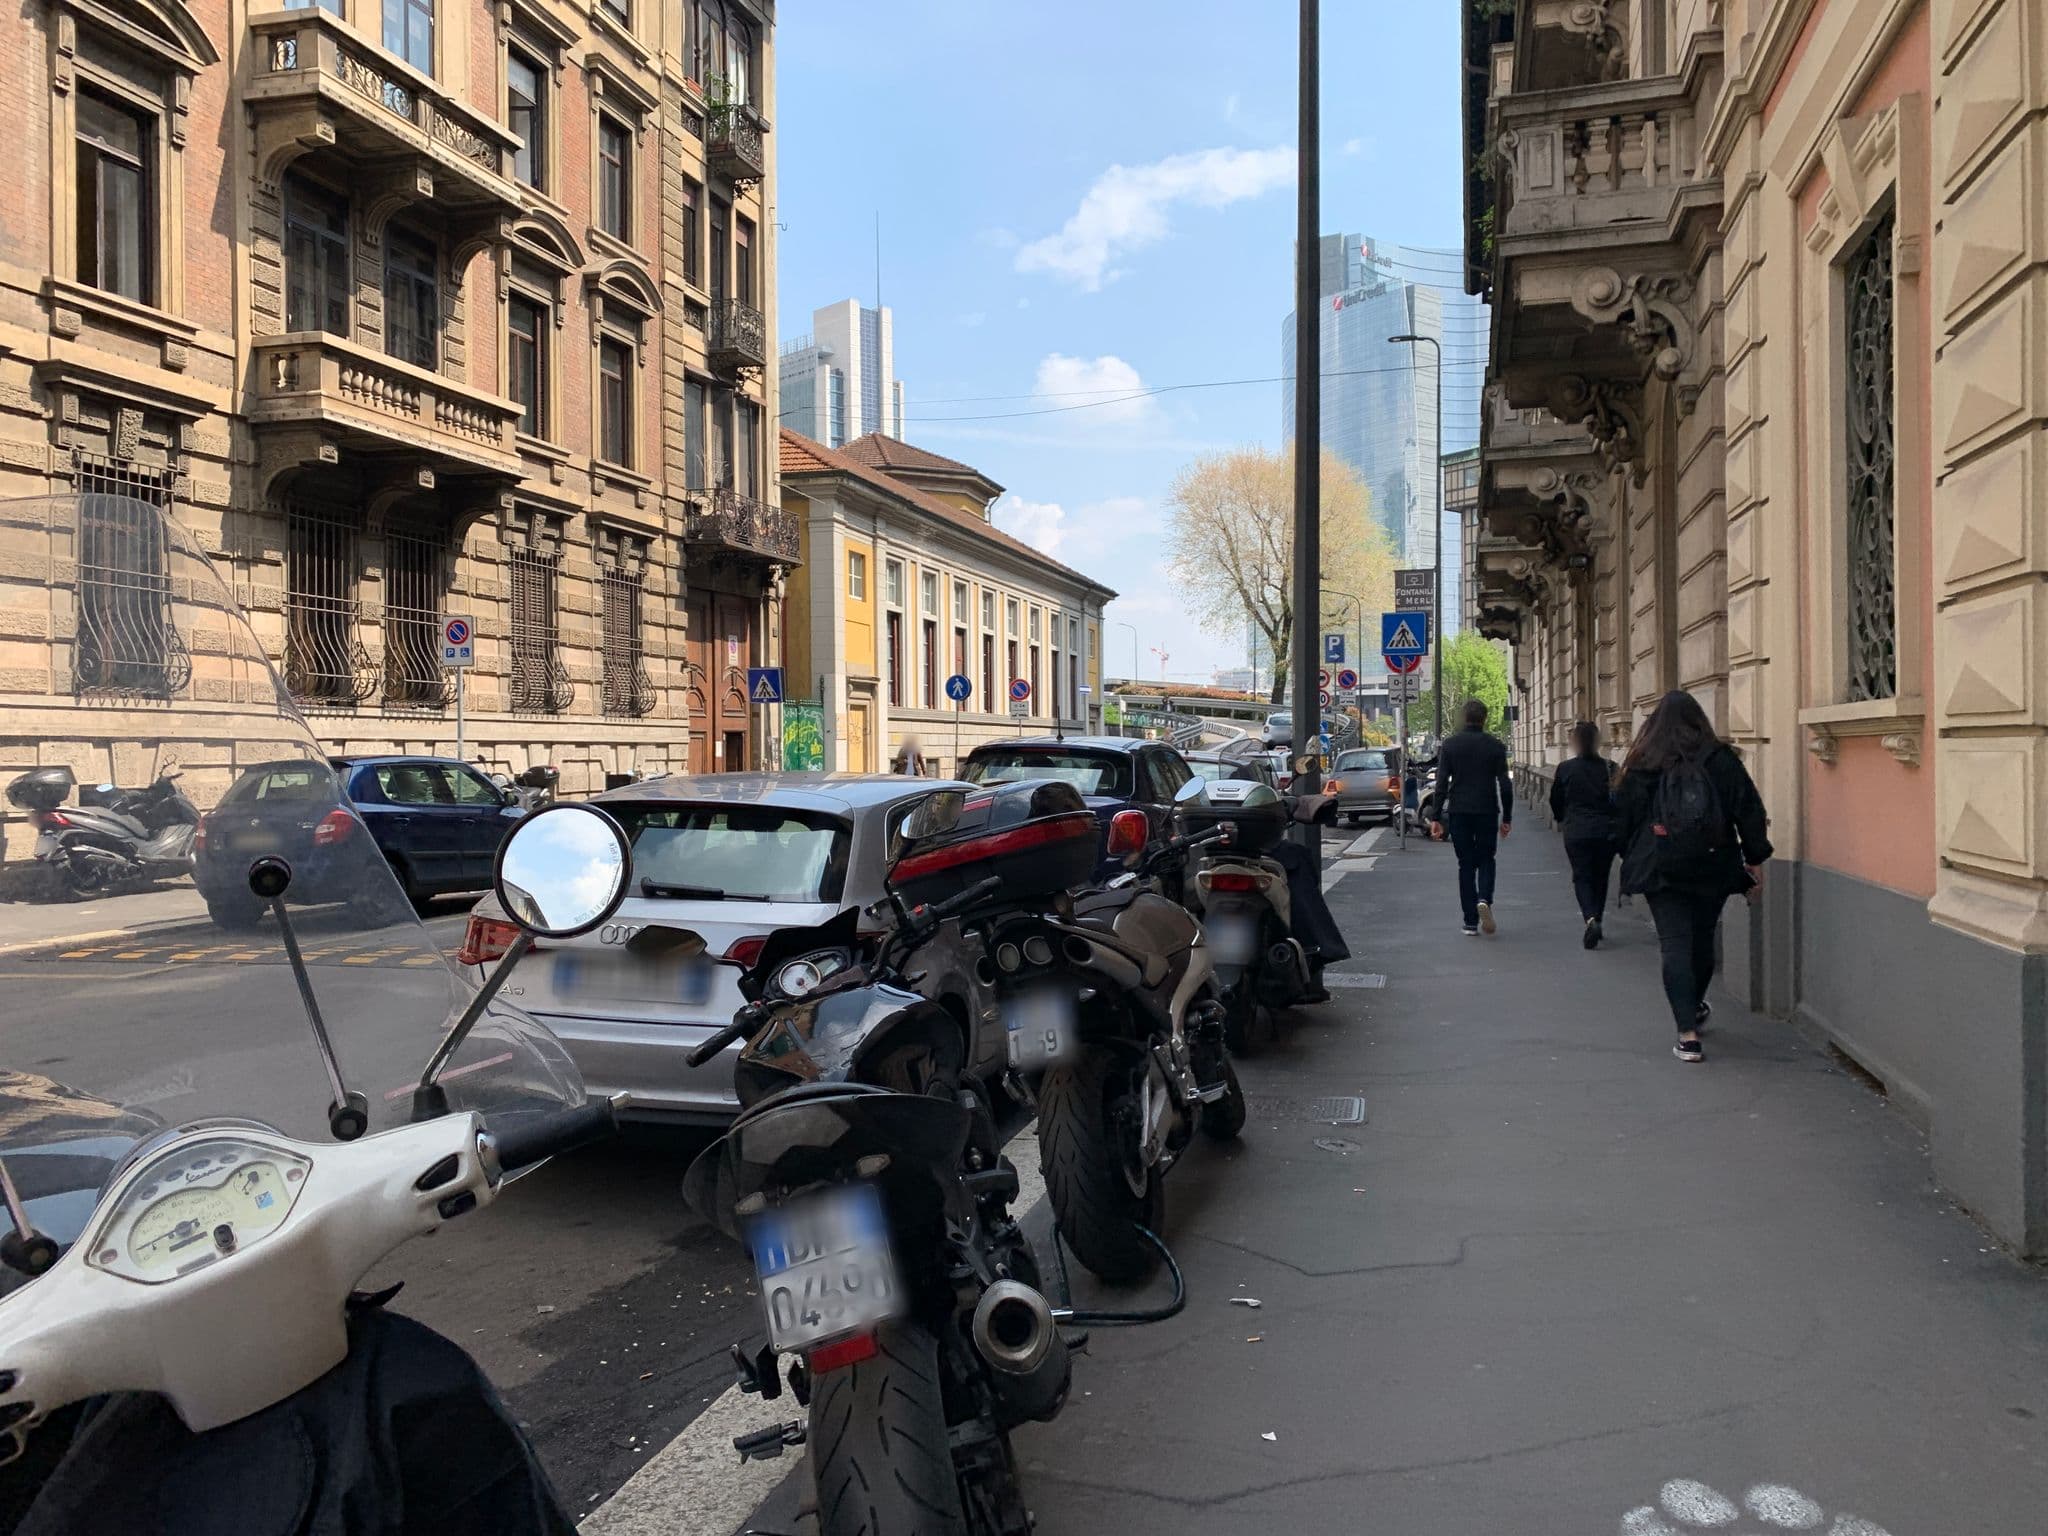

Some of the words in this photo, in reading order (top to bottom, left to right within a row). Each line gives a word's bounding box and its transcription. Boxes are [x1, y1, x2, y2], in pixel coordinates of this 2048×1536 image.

[1343, 282, 1386, 307] UniCredit
[1406, 597, 1433, 605] MERLI
[1328, 636, 1340, 651] P
[447, 649, 454, 657] P
